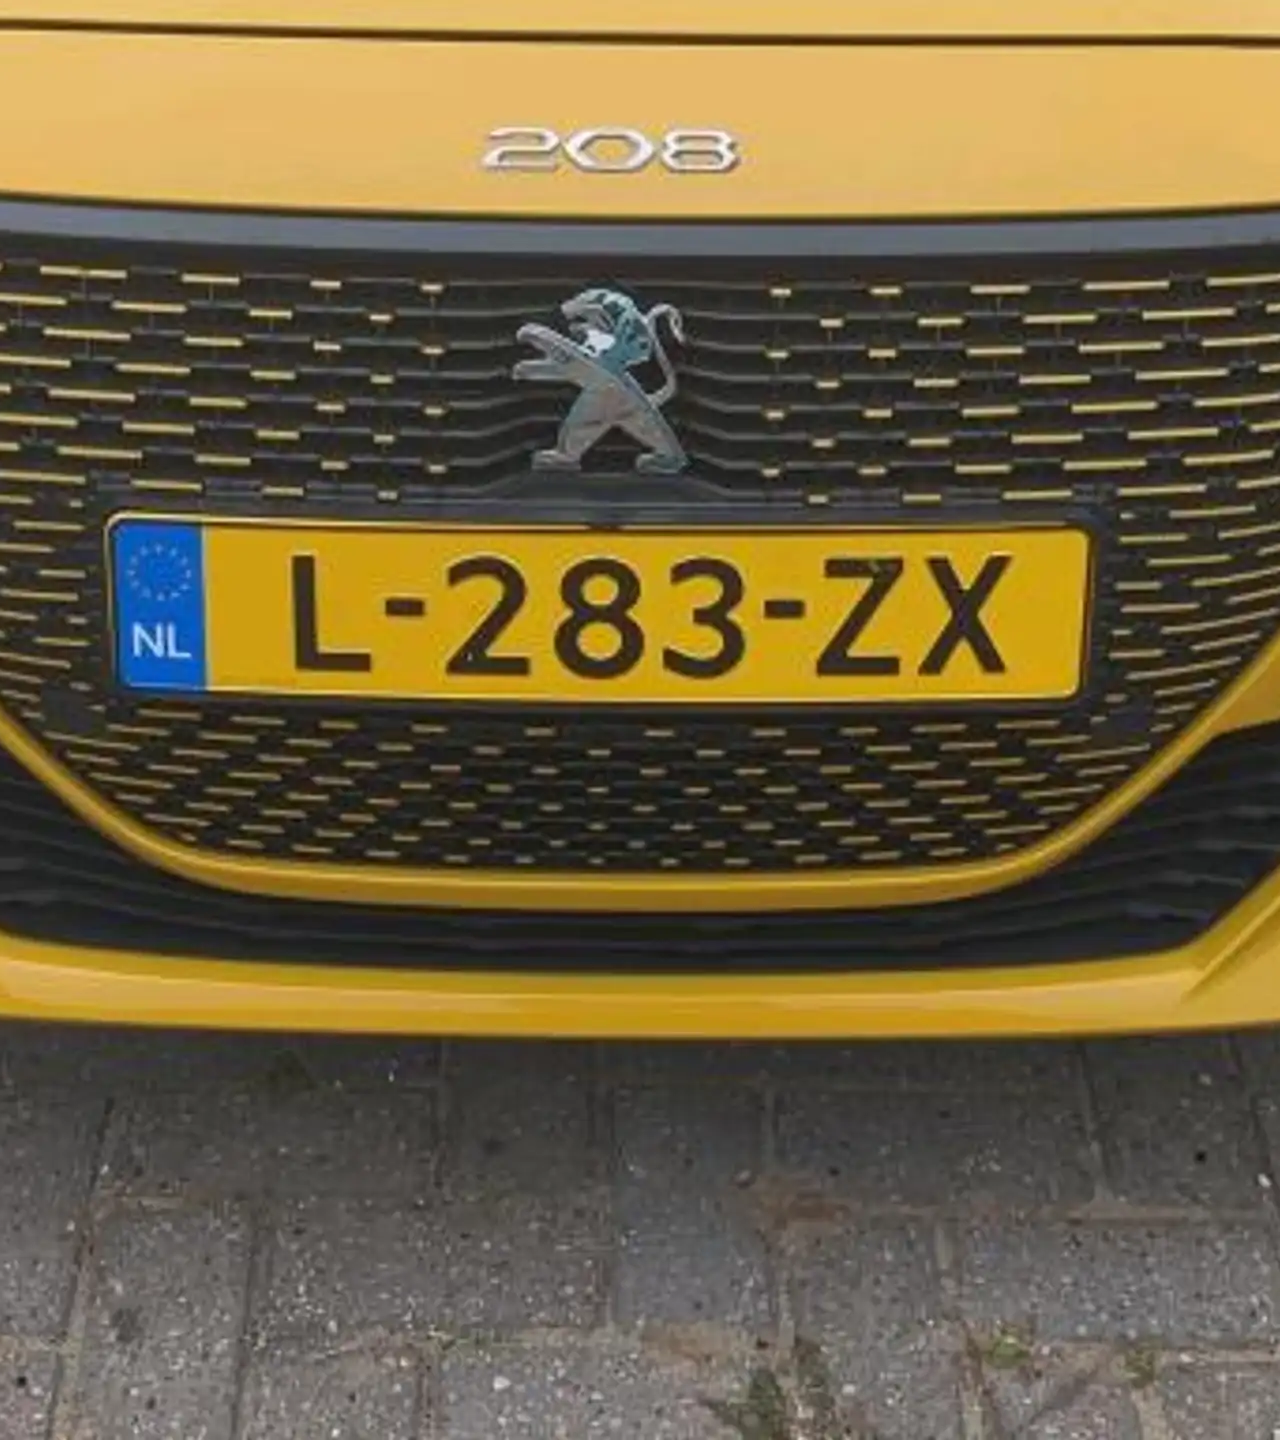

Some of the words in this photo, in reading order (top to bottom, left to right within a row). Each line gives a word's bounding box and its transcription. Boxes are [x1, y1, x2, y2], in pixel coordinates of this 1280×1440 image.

[481, 126, 738, 173] 208
[133, 621, 192, 659] NL
[291, 554, 1013, 679] L-283-ZX
